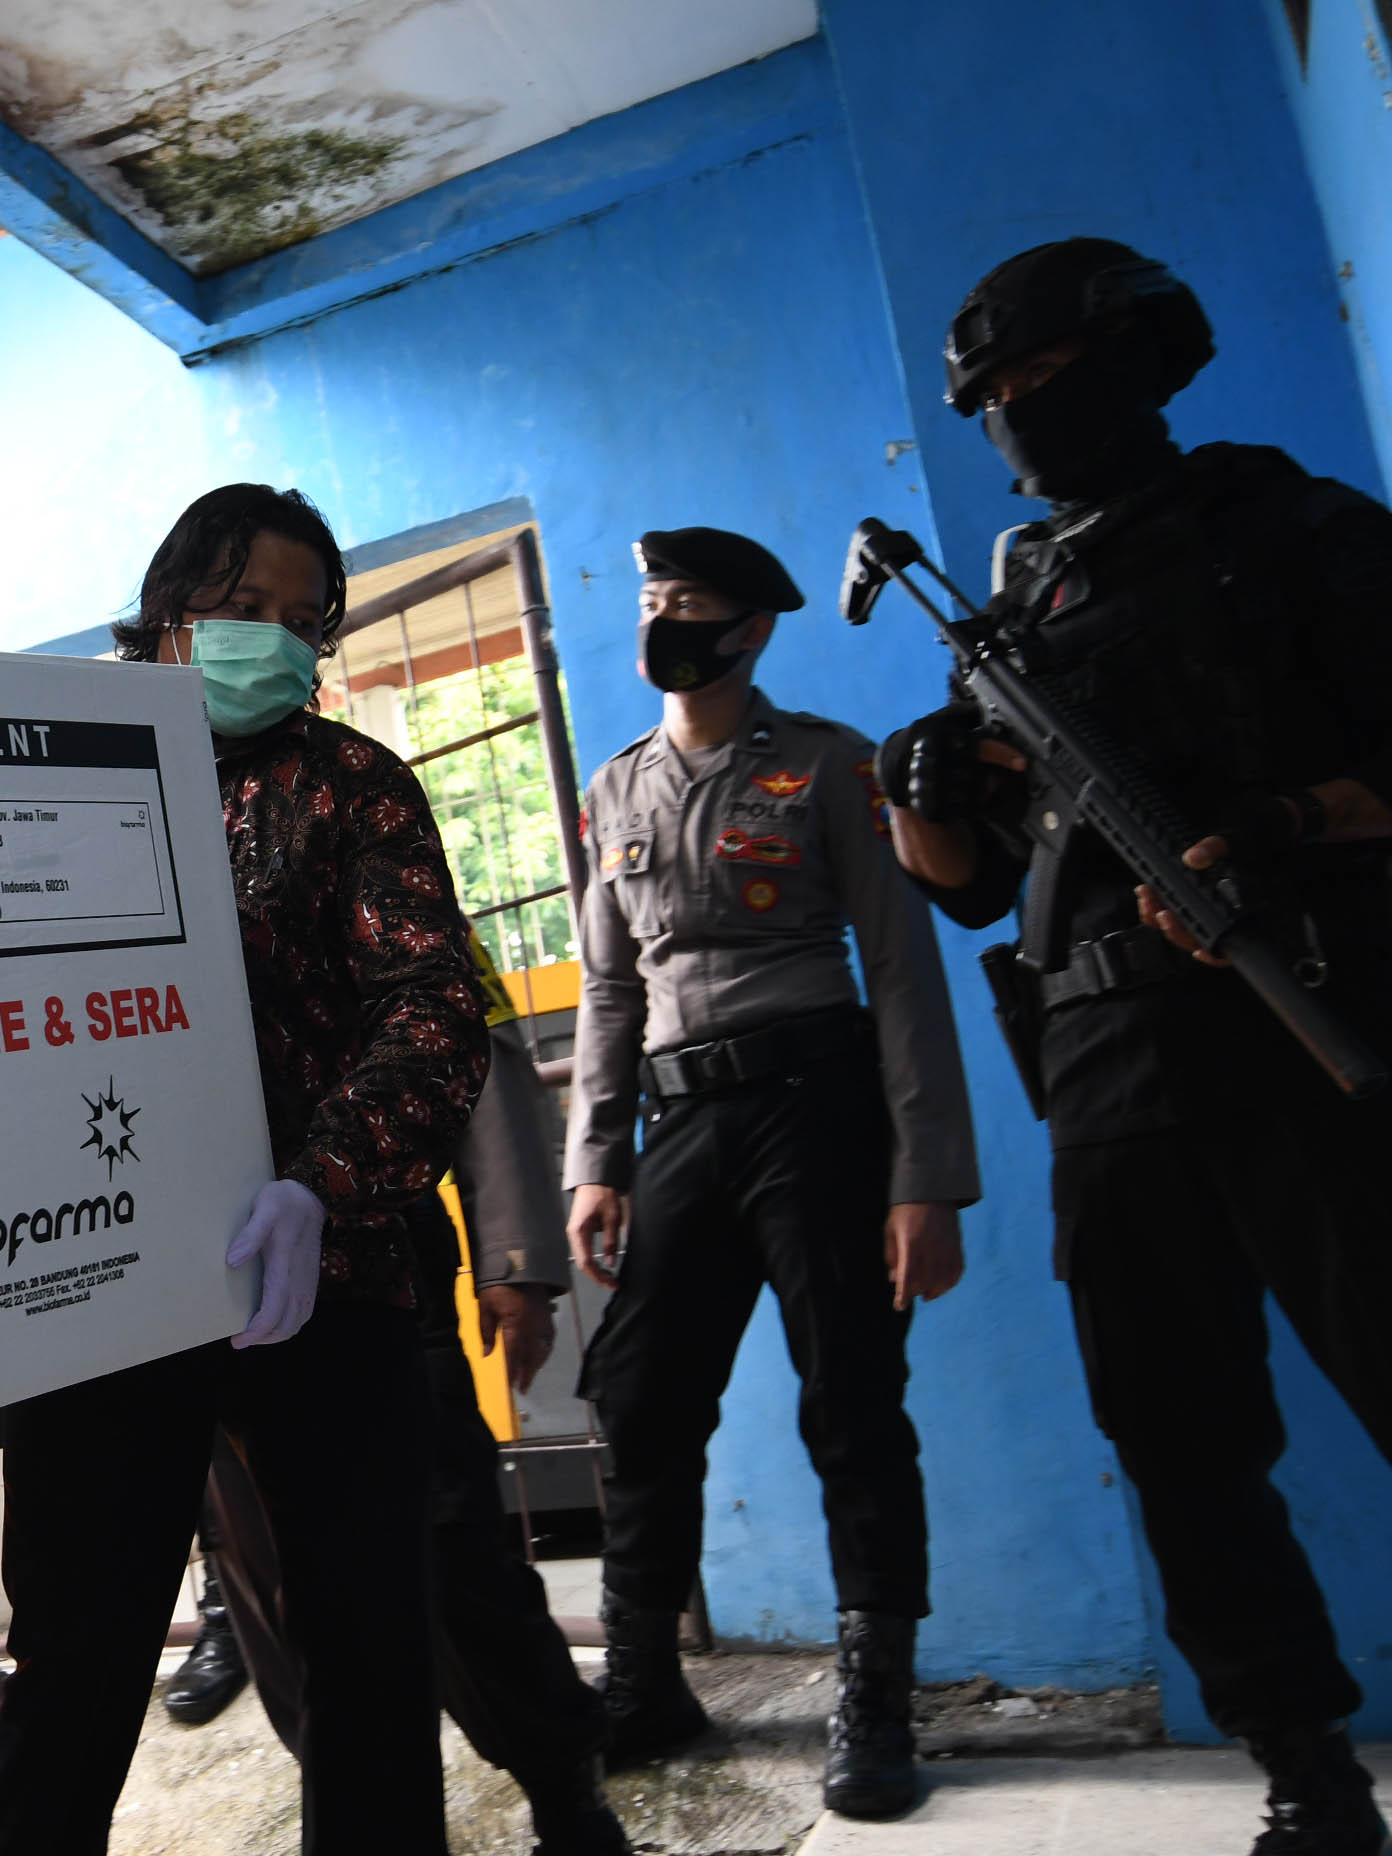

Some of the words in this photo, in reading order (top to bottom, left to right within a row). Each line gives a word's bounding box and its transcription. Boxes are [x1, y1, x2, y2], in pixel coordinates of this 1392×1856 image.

[13, 809, 34, 822] Jawa
[35, 809, 58, 822] Timur
[1, 880, 43, 895] Indonesia,
[45, 879, 70, 892] 60231
[43, 996, 75, 1047] &
[85, 984, 191, 1042] SERA
[40, 1266, 79, 1286] BANDUNG
[101, 1251, 140, 1271] INDONESIA
